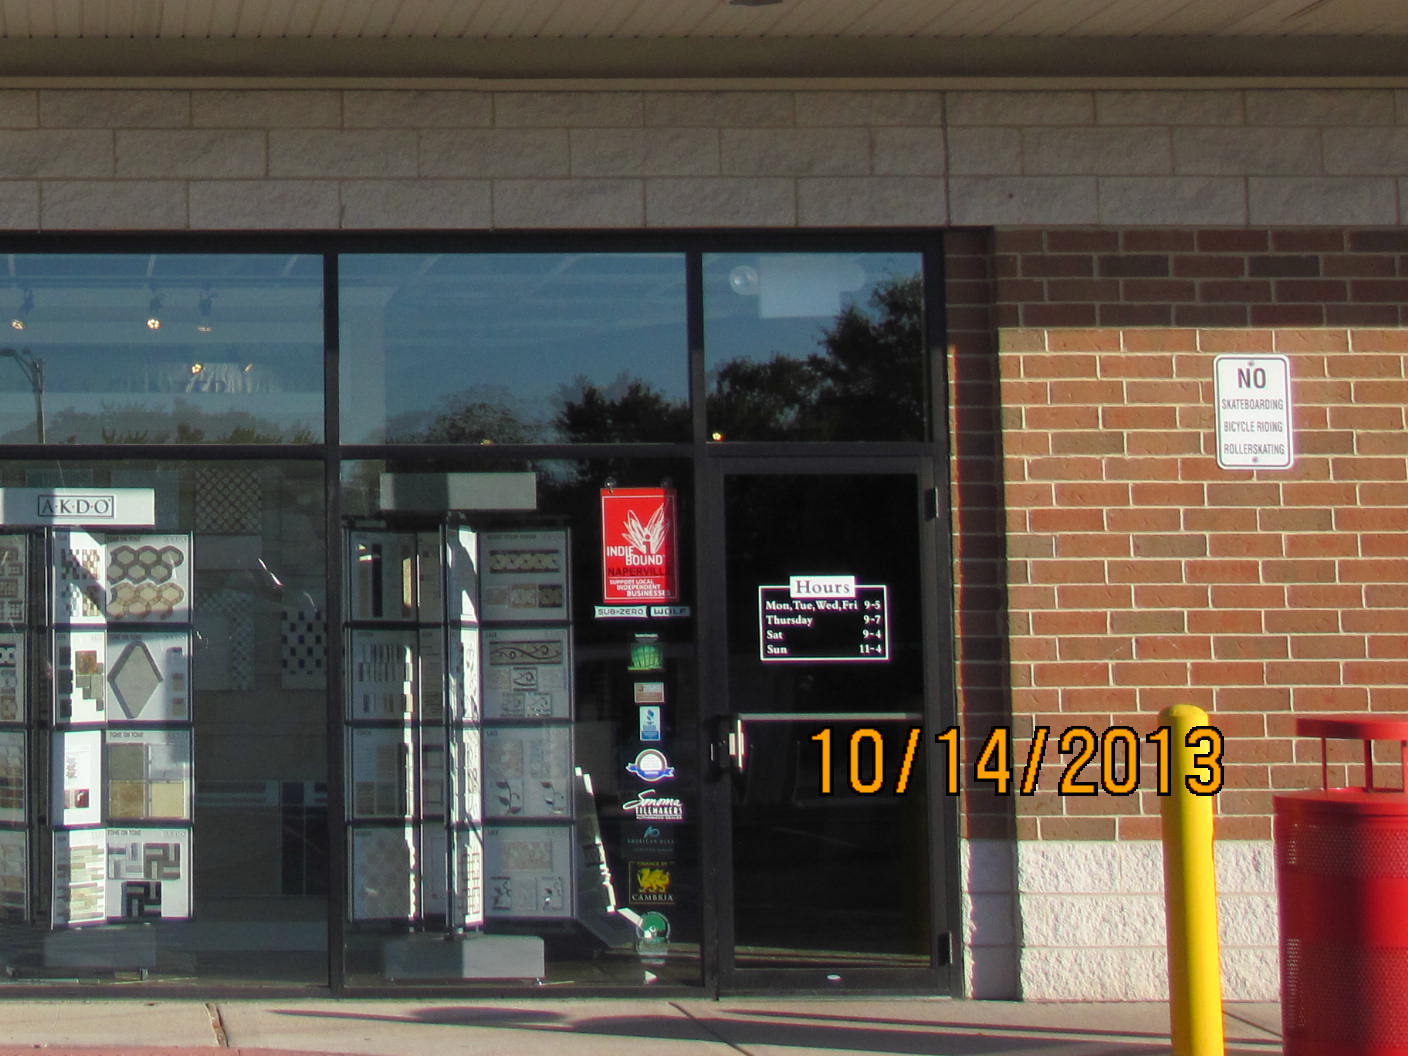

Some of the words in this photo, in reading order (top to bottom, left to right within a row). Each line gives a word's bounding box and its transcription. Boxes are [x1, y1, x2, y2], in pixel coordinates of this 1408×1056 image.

[1238, 368, 1267, 389] NO
[1221, 399, 1284, 410] SKATEBOARDING
[1224, 421, 1255, 432] BICYCLE
[1257, 421, 1283, 433] RIDING
[1224, 443, 1285, 455] ROLLERSKATING
[606, 545, 635, 557] INDIE
[626, 554, 663, 566] BOUND
[796, 580, 850, 594] Hours
[864, 600, 881, 610] 9-5
[765, 615, 813, 626] Thursday
[863, 615, 881, 625] 9-7
[766, 630, 784, 640] Sat
[862, 630, 881, 639] 9-4
[767, 645, 788, 655] Sun
[859, 645, 882, 654] 11-4
[631, 894, 674, 902] CAMBRIA
